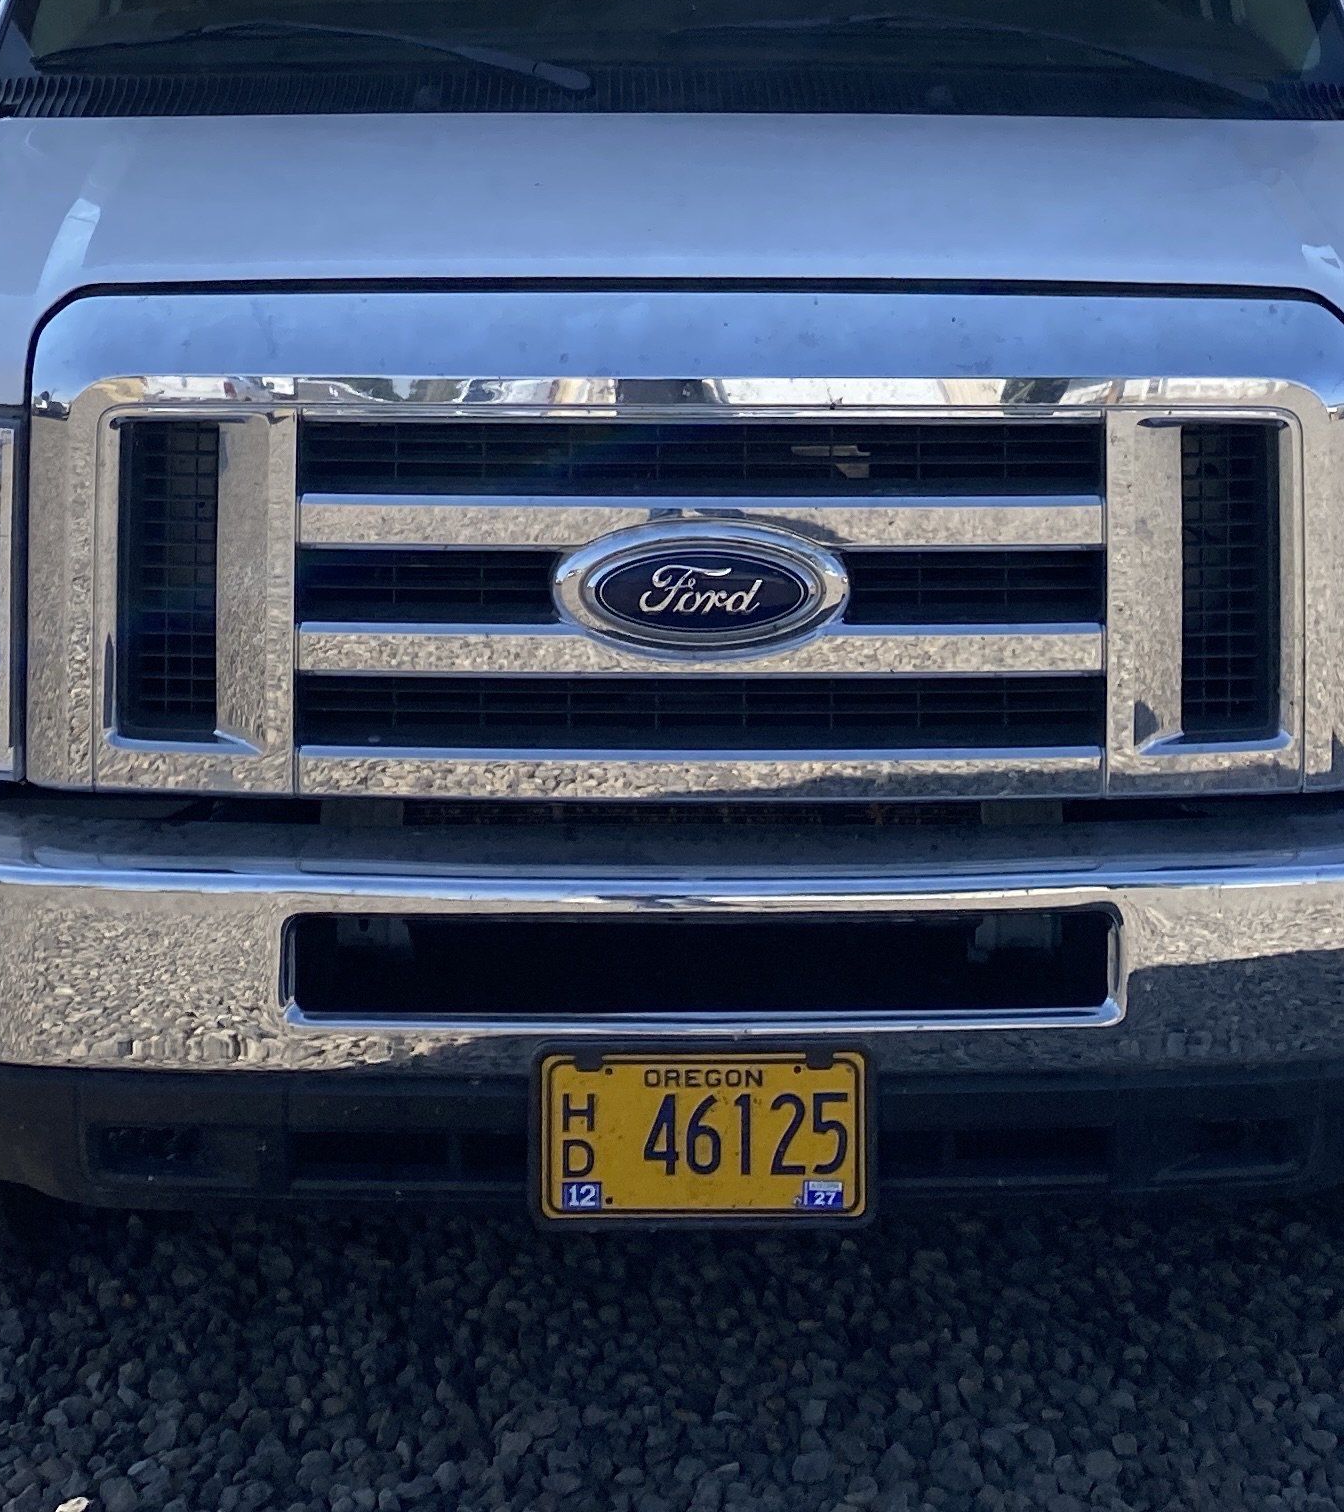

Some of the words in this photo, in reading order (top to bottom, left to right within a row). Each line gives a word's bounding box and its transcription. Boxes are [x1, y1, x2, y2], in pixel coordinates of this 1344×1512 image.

[639, 564, 763, 615] Ford
[644, 1069, 763, 1088] OREGON
[643, 1093, 849, 1176] 46125
[568, 1184, 596, 1207] 12
[813, 1191, 837, 1206] 27
